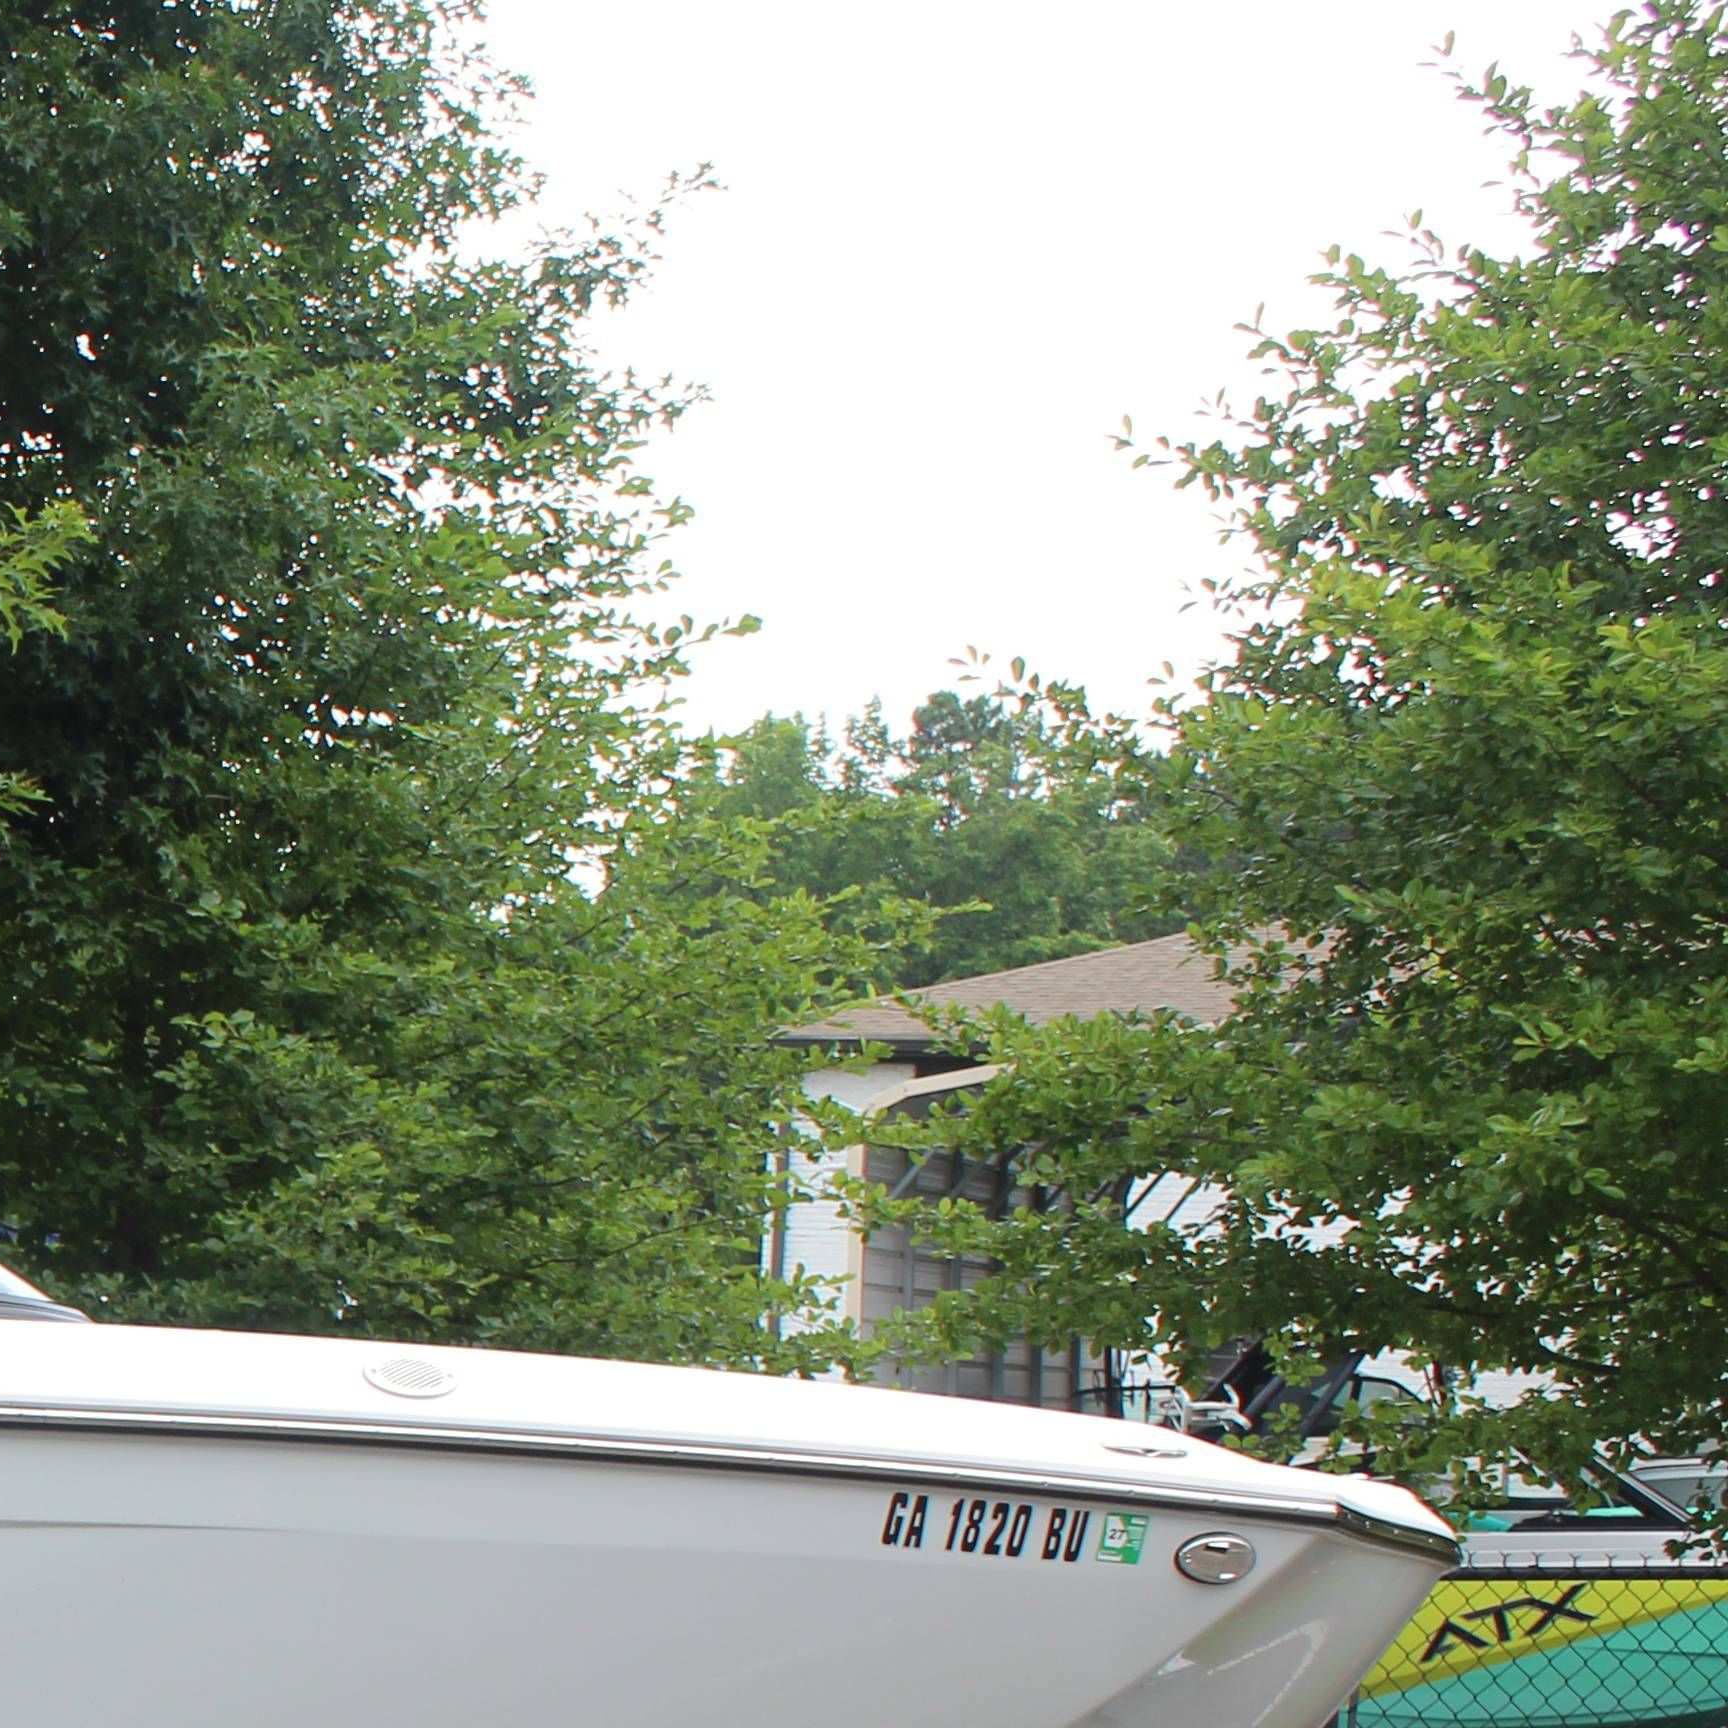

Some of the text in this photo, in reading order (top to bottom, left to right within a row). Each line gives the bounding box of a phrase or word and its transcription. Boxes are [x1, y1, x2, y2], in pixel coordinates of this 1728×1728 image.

[882, 1492, 1090, 1562] GA 1820 BU
[1108, 1529, 1127, 1540] 27
[1420, 1582, 1598, 1663] ATX
